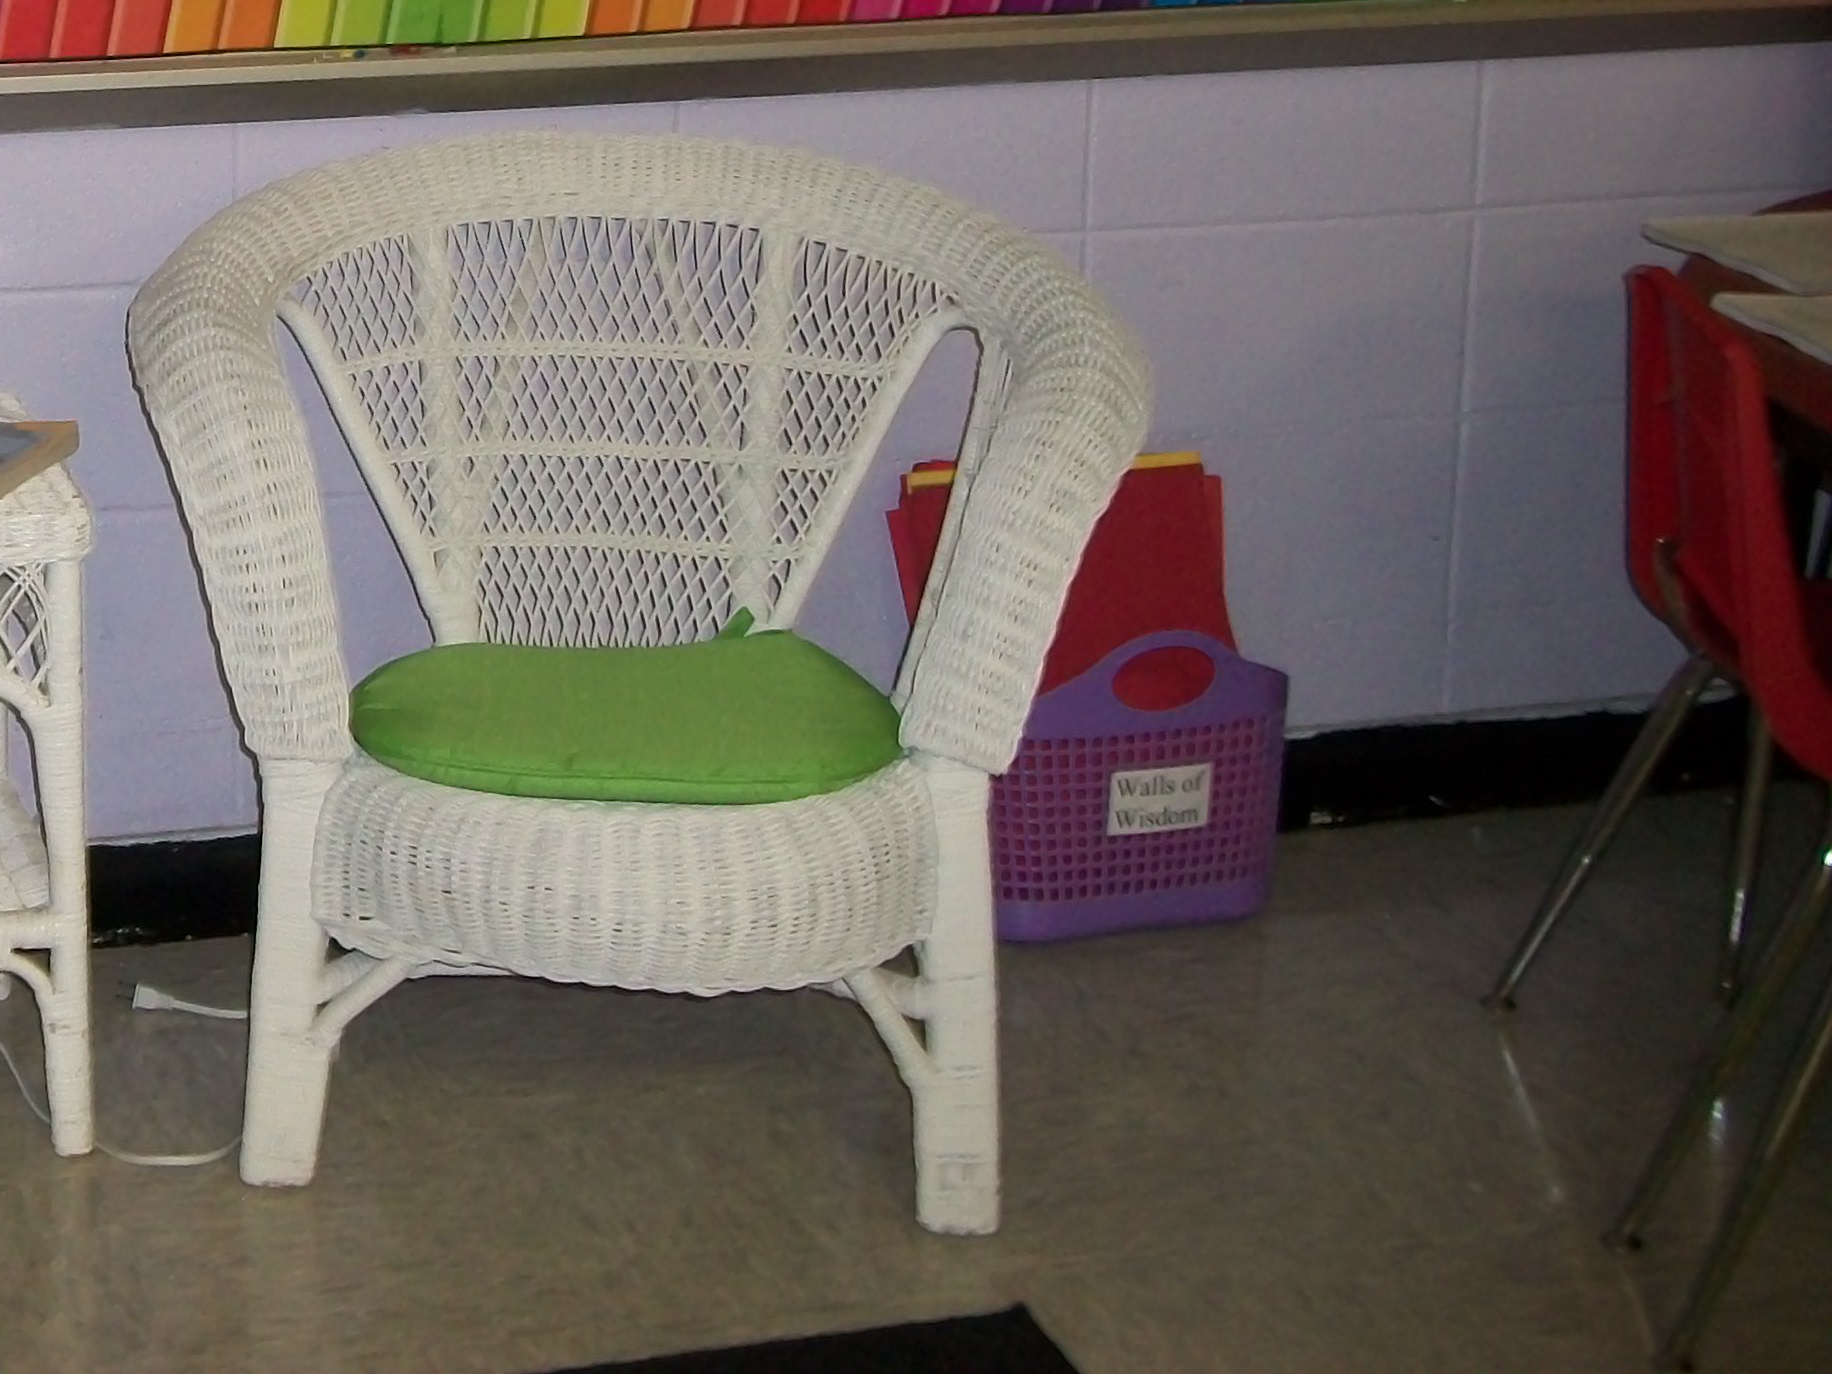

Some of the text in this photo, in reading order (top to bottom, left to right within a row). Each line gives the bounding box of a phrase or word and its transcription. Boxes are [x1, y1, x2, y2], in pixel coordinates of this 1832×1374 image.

[1117, 770, 1205, 798] Walls of
[1115, 807, 1198, 829] Wisdom
